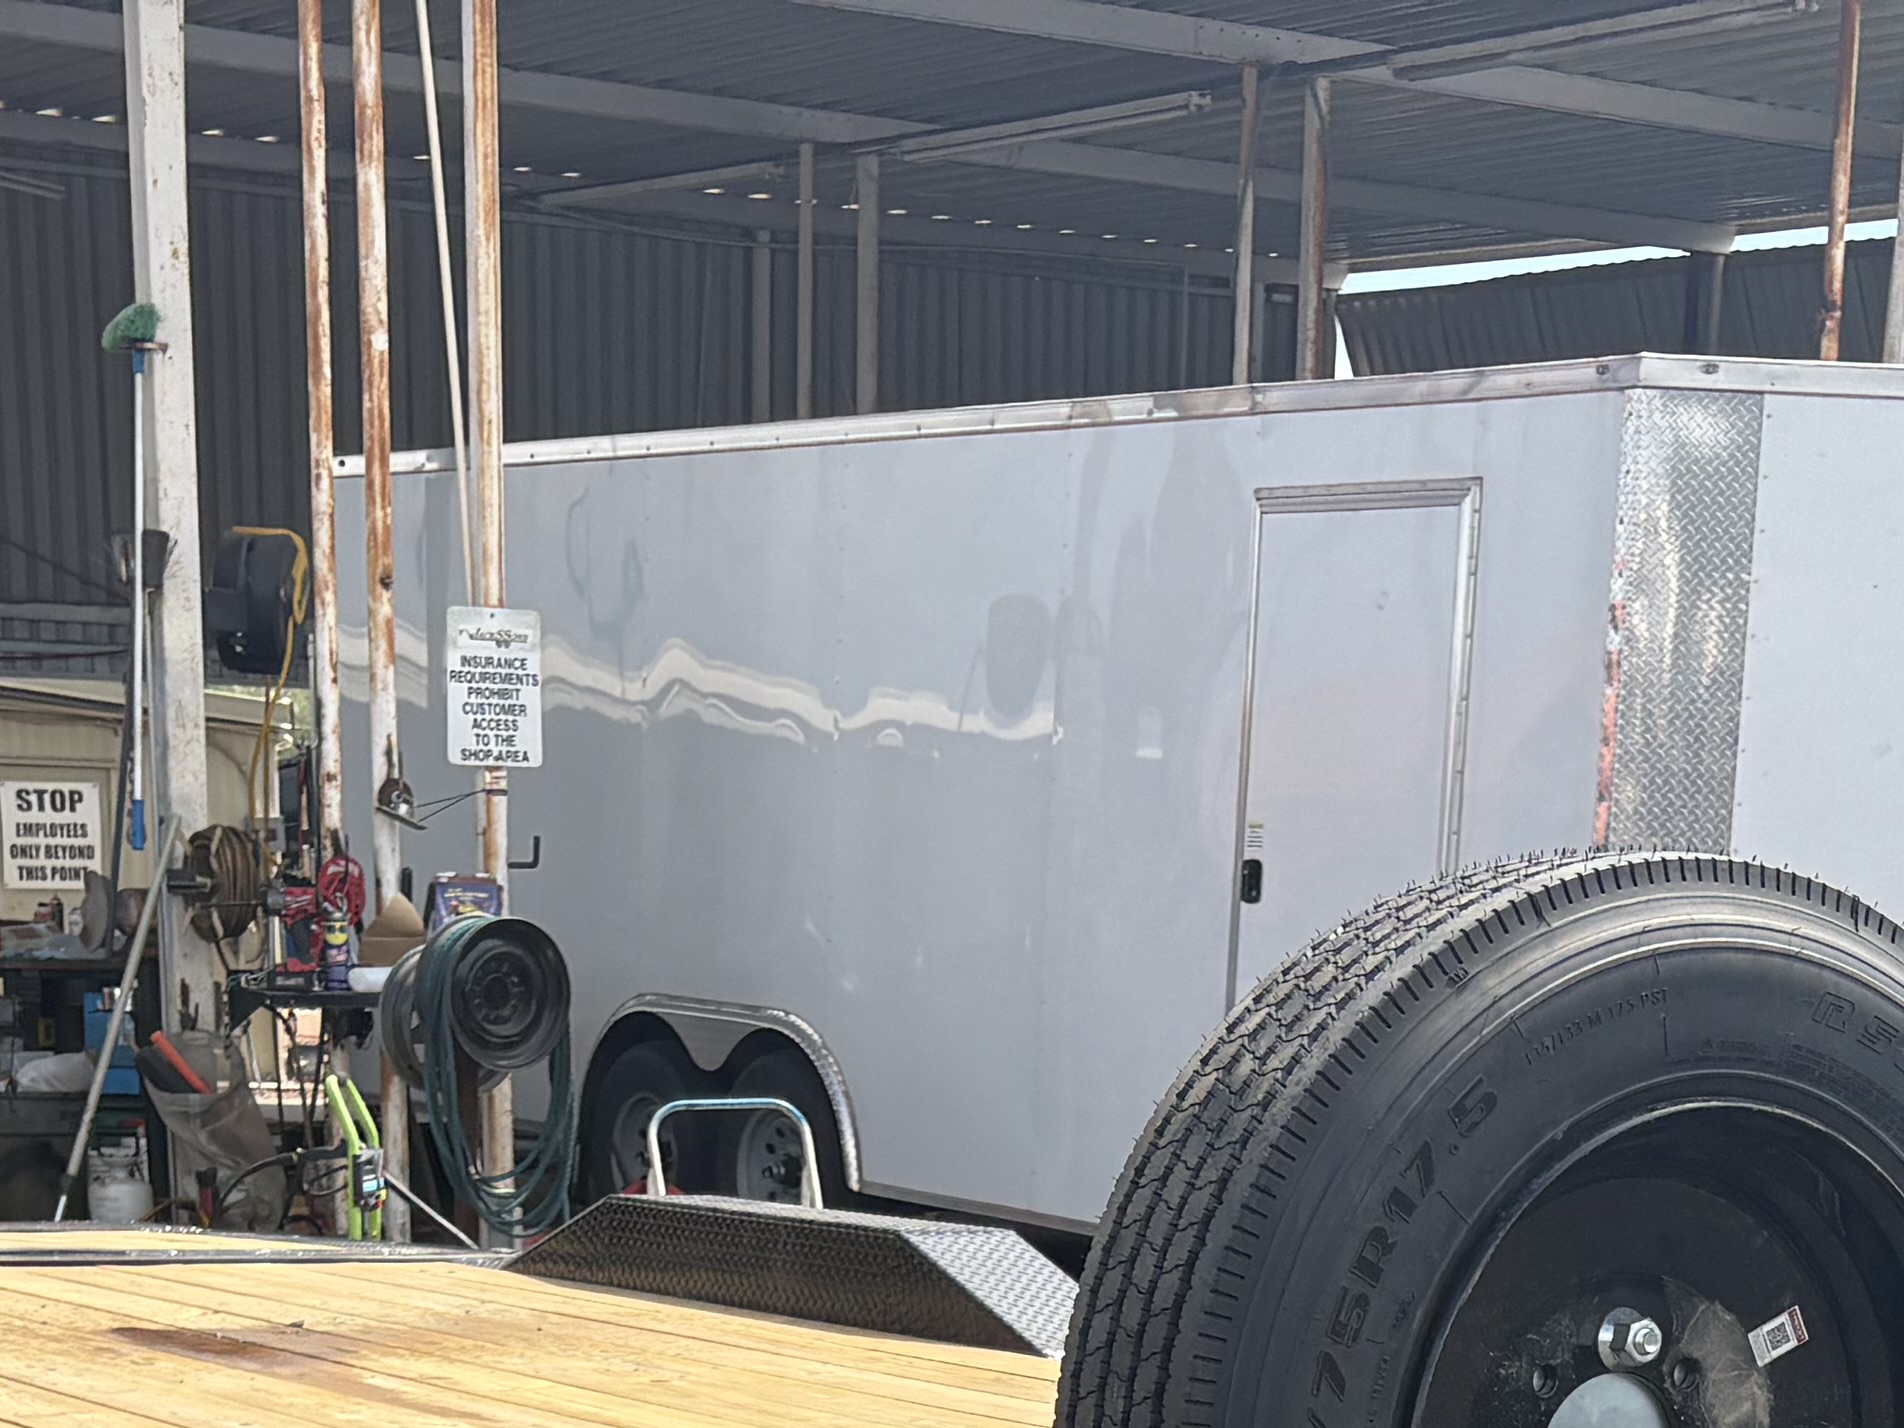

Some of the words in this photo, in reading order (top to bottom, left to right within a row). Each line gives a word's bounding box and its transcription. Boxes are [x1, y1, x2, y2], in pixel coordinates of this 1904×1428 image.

[460, 655, 528, 671] INSURANCE
[449, 670, 540, 687] REQUIREMENTS
[467, 686, 521, 701] PROHIBIT
[462, 702, 527, 717] CUSTOMER
[471, 718, 519, 732] ACCESS
[474, 733, 491, 747] TO
[494, 734, 517, 748] THE
[460, 748, 494, 762] SHOP
[495, 750, 530, 763] AREA
[15, 788, 84, 813] STOP
[15, 822, 89, 838] EMPLOYEES
[9, 843, 41, 860] ONLY
[44, 844, 95, 860] BEYOND
[17, 865, 49, 881] THIS
